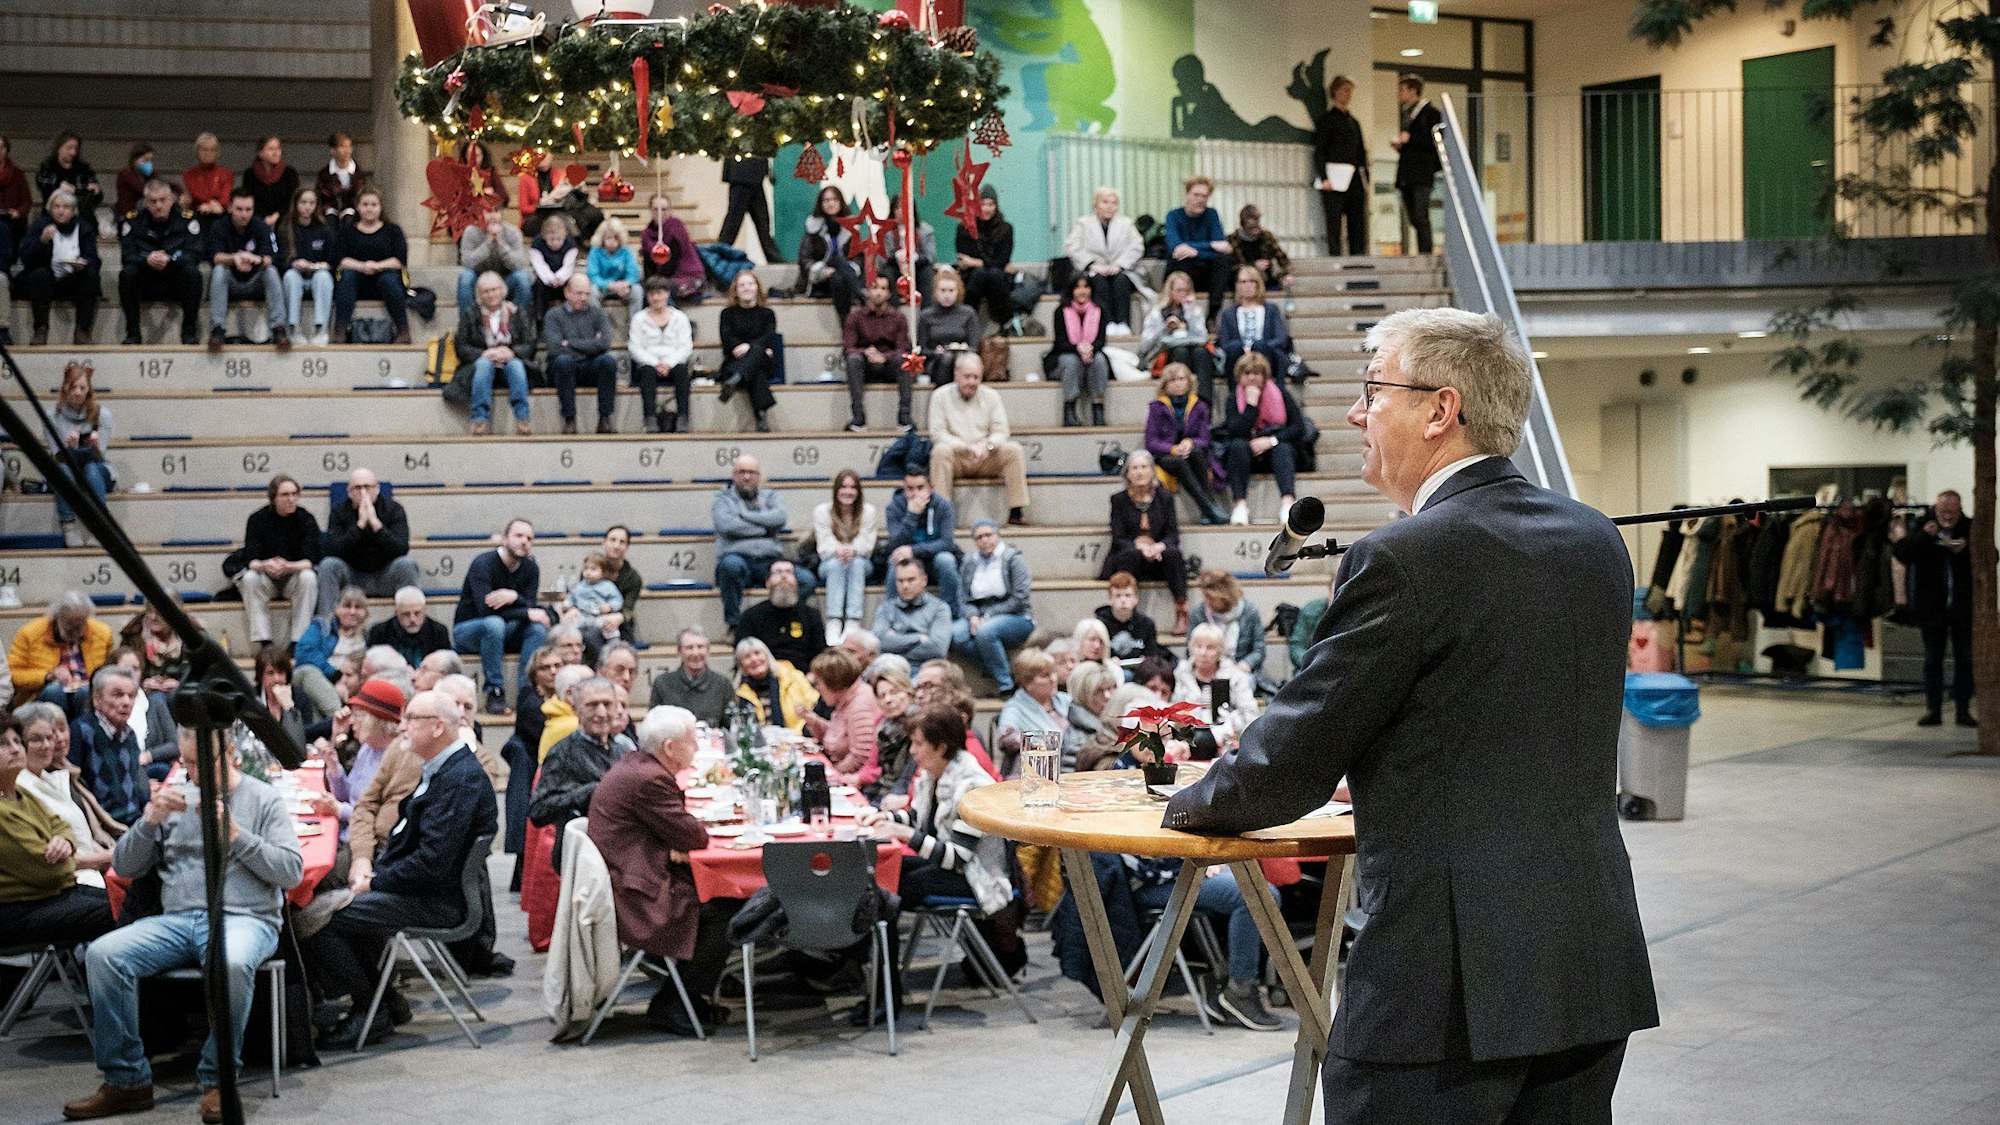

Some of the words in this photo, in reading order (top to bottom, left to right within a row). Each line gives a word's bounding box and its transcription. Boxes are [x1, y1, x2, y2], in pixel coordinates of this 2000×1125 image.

[139, 359, 174, 378] 187
[226, 358, 251, 378] 88
[302, 358, 328, 378] 89
[378, 358, 391, 378] 9
[561, 448, 574, 469] 6
[639, 447, 665, 467] 67
[793, 446, 820, 466] 69
[1021, 441, 1044, 461] 2
[162, 454, 186, 475] 61
[243, 453, 270, 473] 62
[323, 452, 350, 472] 63
[669, 550, 696, 571] 42
[1074, 543, 1101, 562] 47
[1235, 541, 1261, 560] 49
[168, 561, 197, 583] 36
